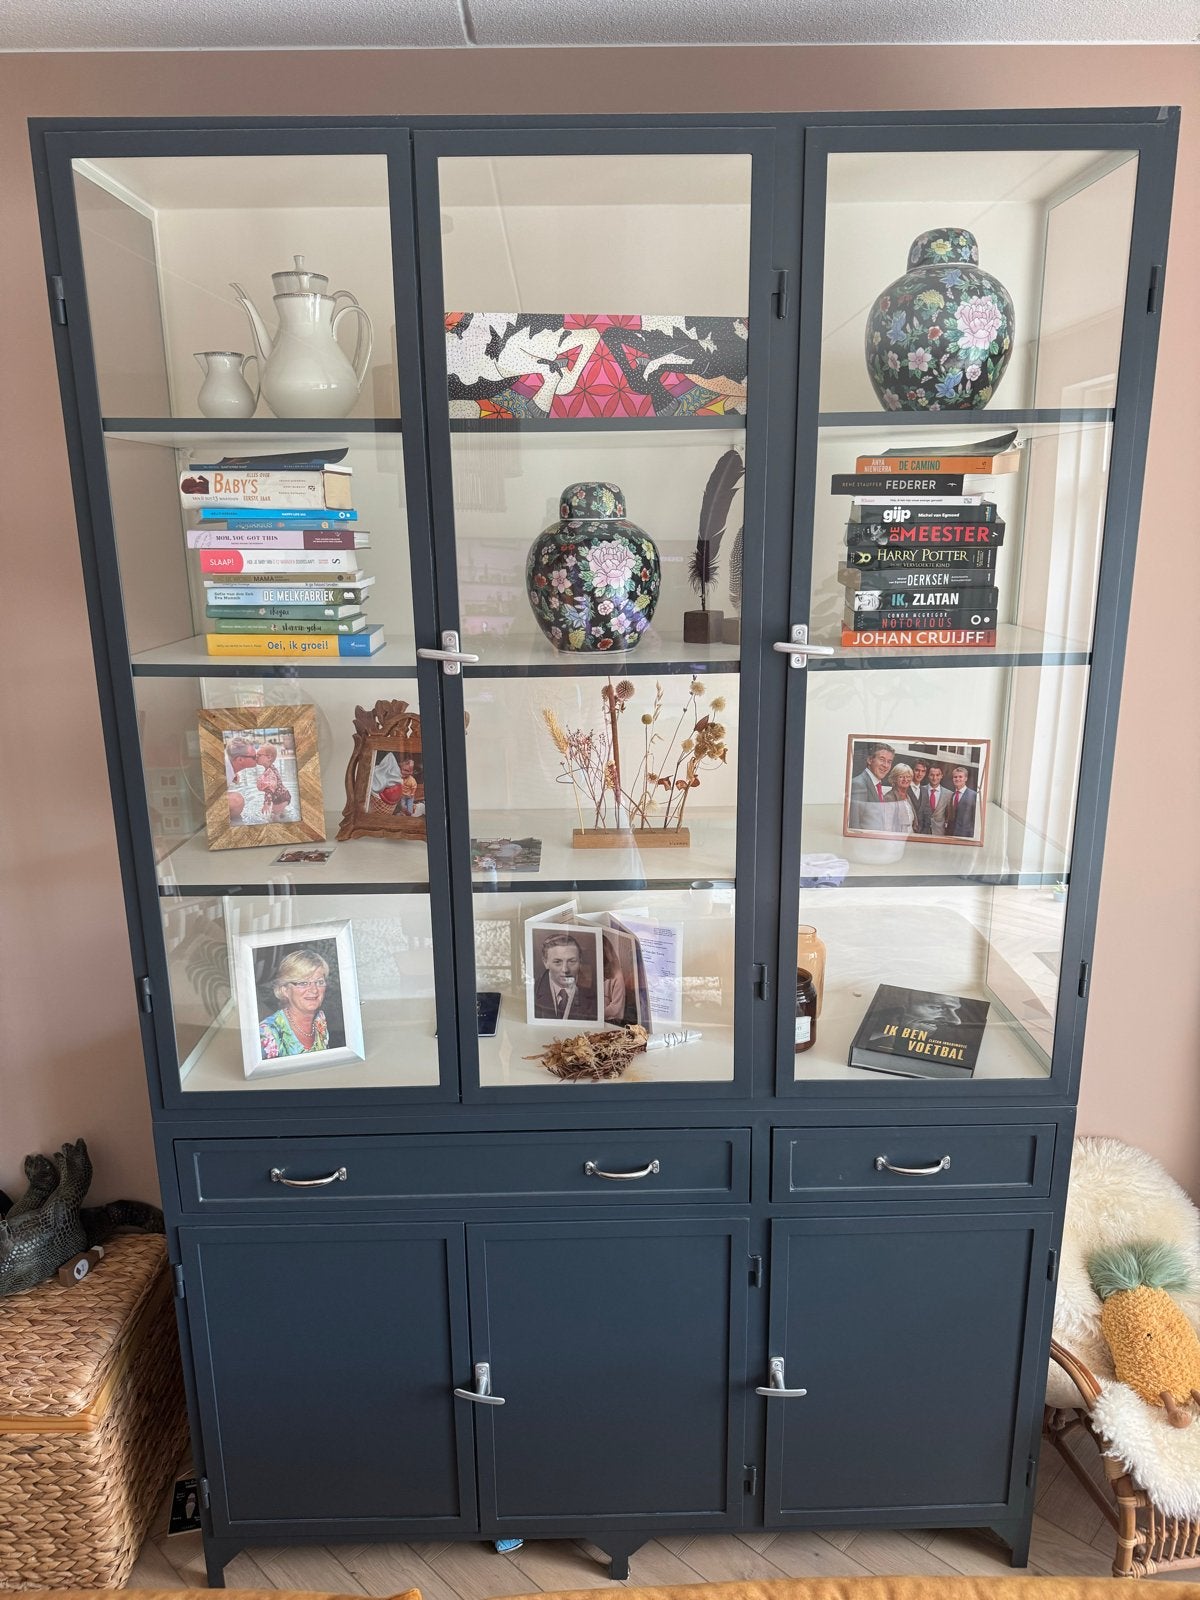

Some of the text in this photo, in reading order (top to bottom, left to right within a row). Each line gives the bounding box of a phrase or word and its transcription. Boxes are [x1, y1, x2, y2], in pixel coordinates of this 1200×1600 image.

[899, 460, 941, 471] DE CAMINO
[886, 480, 936, 490] FEDERER
[883, 506, 911, 522] gijp
[890, 526, 990, 542] DE MEESTER
[878, 549, 919, 562] HARRY
[922, 549, 970, 562] POTTER
[908, 574, 950, 586] DERKSEN
[264, 590, 334, 601] DE MELKFABRIEK
[892, 593, 959, 608] IK, ZLATAN
[882, 618, 952, 628] NOTORIOUS
[853, 632, 984, 644] JOHAN CRUIJFF
[268, 642, 286, 650] Oei,
[301, 642, 328, 652] groei!
[884, 1024, 928, 1041] IK BEN
[908, 1040, 964, 1060] VOETBAL
